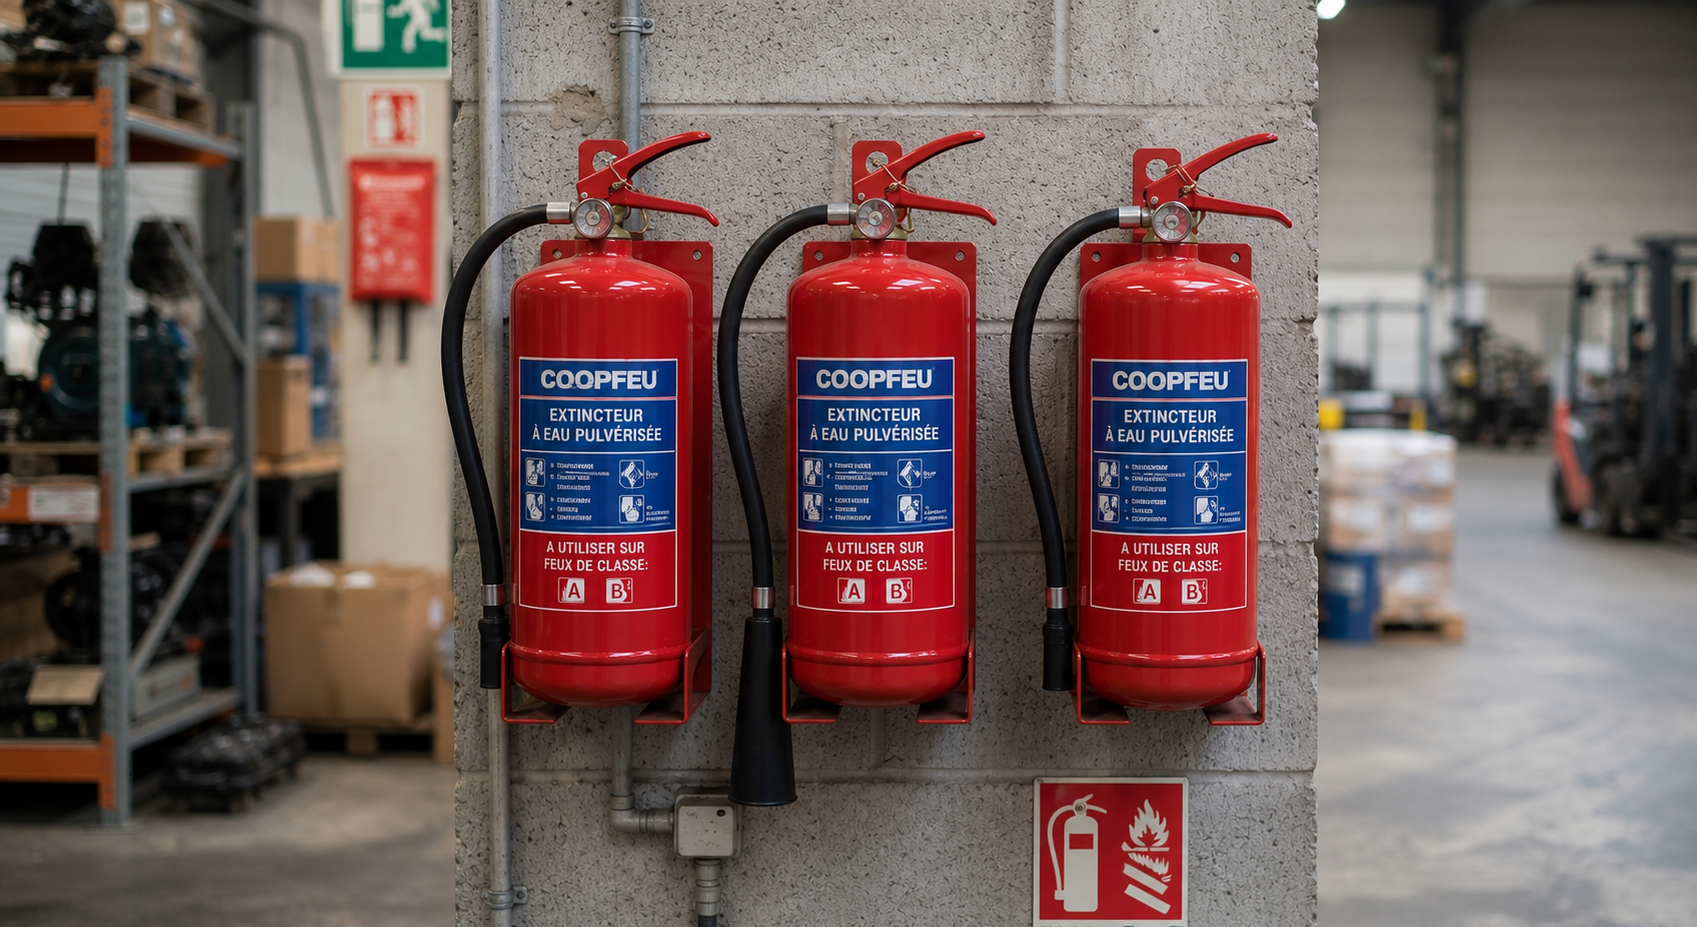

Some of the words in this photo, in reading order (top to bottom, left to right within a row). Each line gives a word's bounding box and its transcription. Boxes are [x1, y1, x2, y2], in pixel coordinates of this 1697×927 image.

[540, 369, 657, 390] COOPFEU
[816, 369, 932, 389] COOPFEU
[1112, 370, 1229, 391] COOPFEU
[550, 408, 643, 422] EXTINCTEUR
[828, 408, 920, 422] EXTINCTEUR
[1124, 409, 1217, 424] EXTINCTEUR
[532, 424, 540, 440] À
[544, 427, 569, 441] EAU
[575, 425, 662, 442] PULVÉRISÉE
[810, 424, 818, 440] À
[821, 427, 848, 441] EAU
[854, 424, 939, 441] PULVÉRISÉE
[1105, 425, 1114, 442] À
[1118, 429, 1145, 443] EAU
[1150, 426, 1234, 443] PULVÉRISÉE
[546, 541, 554, 553] A
[558, 541, 615, 554] UTILISER
[620, 541, 645, 553] SUR
[825, 541, 833, 554] A
[837, 542, 895, 554] UTILISER
[899, 541, 924, 554] SUR
[1121, 542, 1129, 554] A
[1133, 543, 1190, 555] UTILISER
[1195, 542, 1219, 554] SUR
[544, 558, 572, 571] FEUX
[577, 559, 593, 571] DE
[597, 558, 648, 571] CLASSE:
[823, 558, 852, 571] FEUX
[856, 560, 873, 572] DE
[877, 558, 927, 572] CLASSE:
[1118, 559, 1148, 572] FEUX
[1152, 561, 1169, 573] DE
[1173, 559, 1222, 572] CLASSE:
[568, 582, 581, 599] A
[611, 583, 624, 598] B
[848, 582, 861, 599] A
[891, 583, 904, 599] B
[1143, 583, 1157, 600] A
[1187, 584, 1200, 600] B
